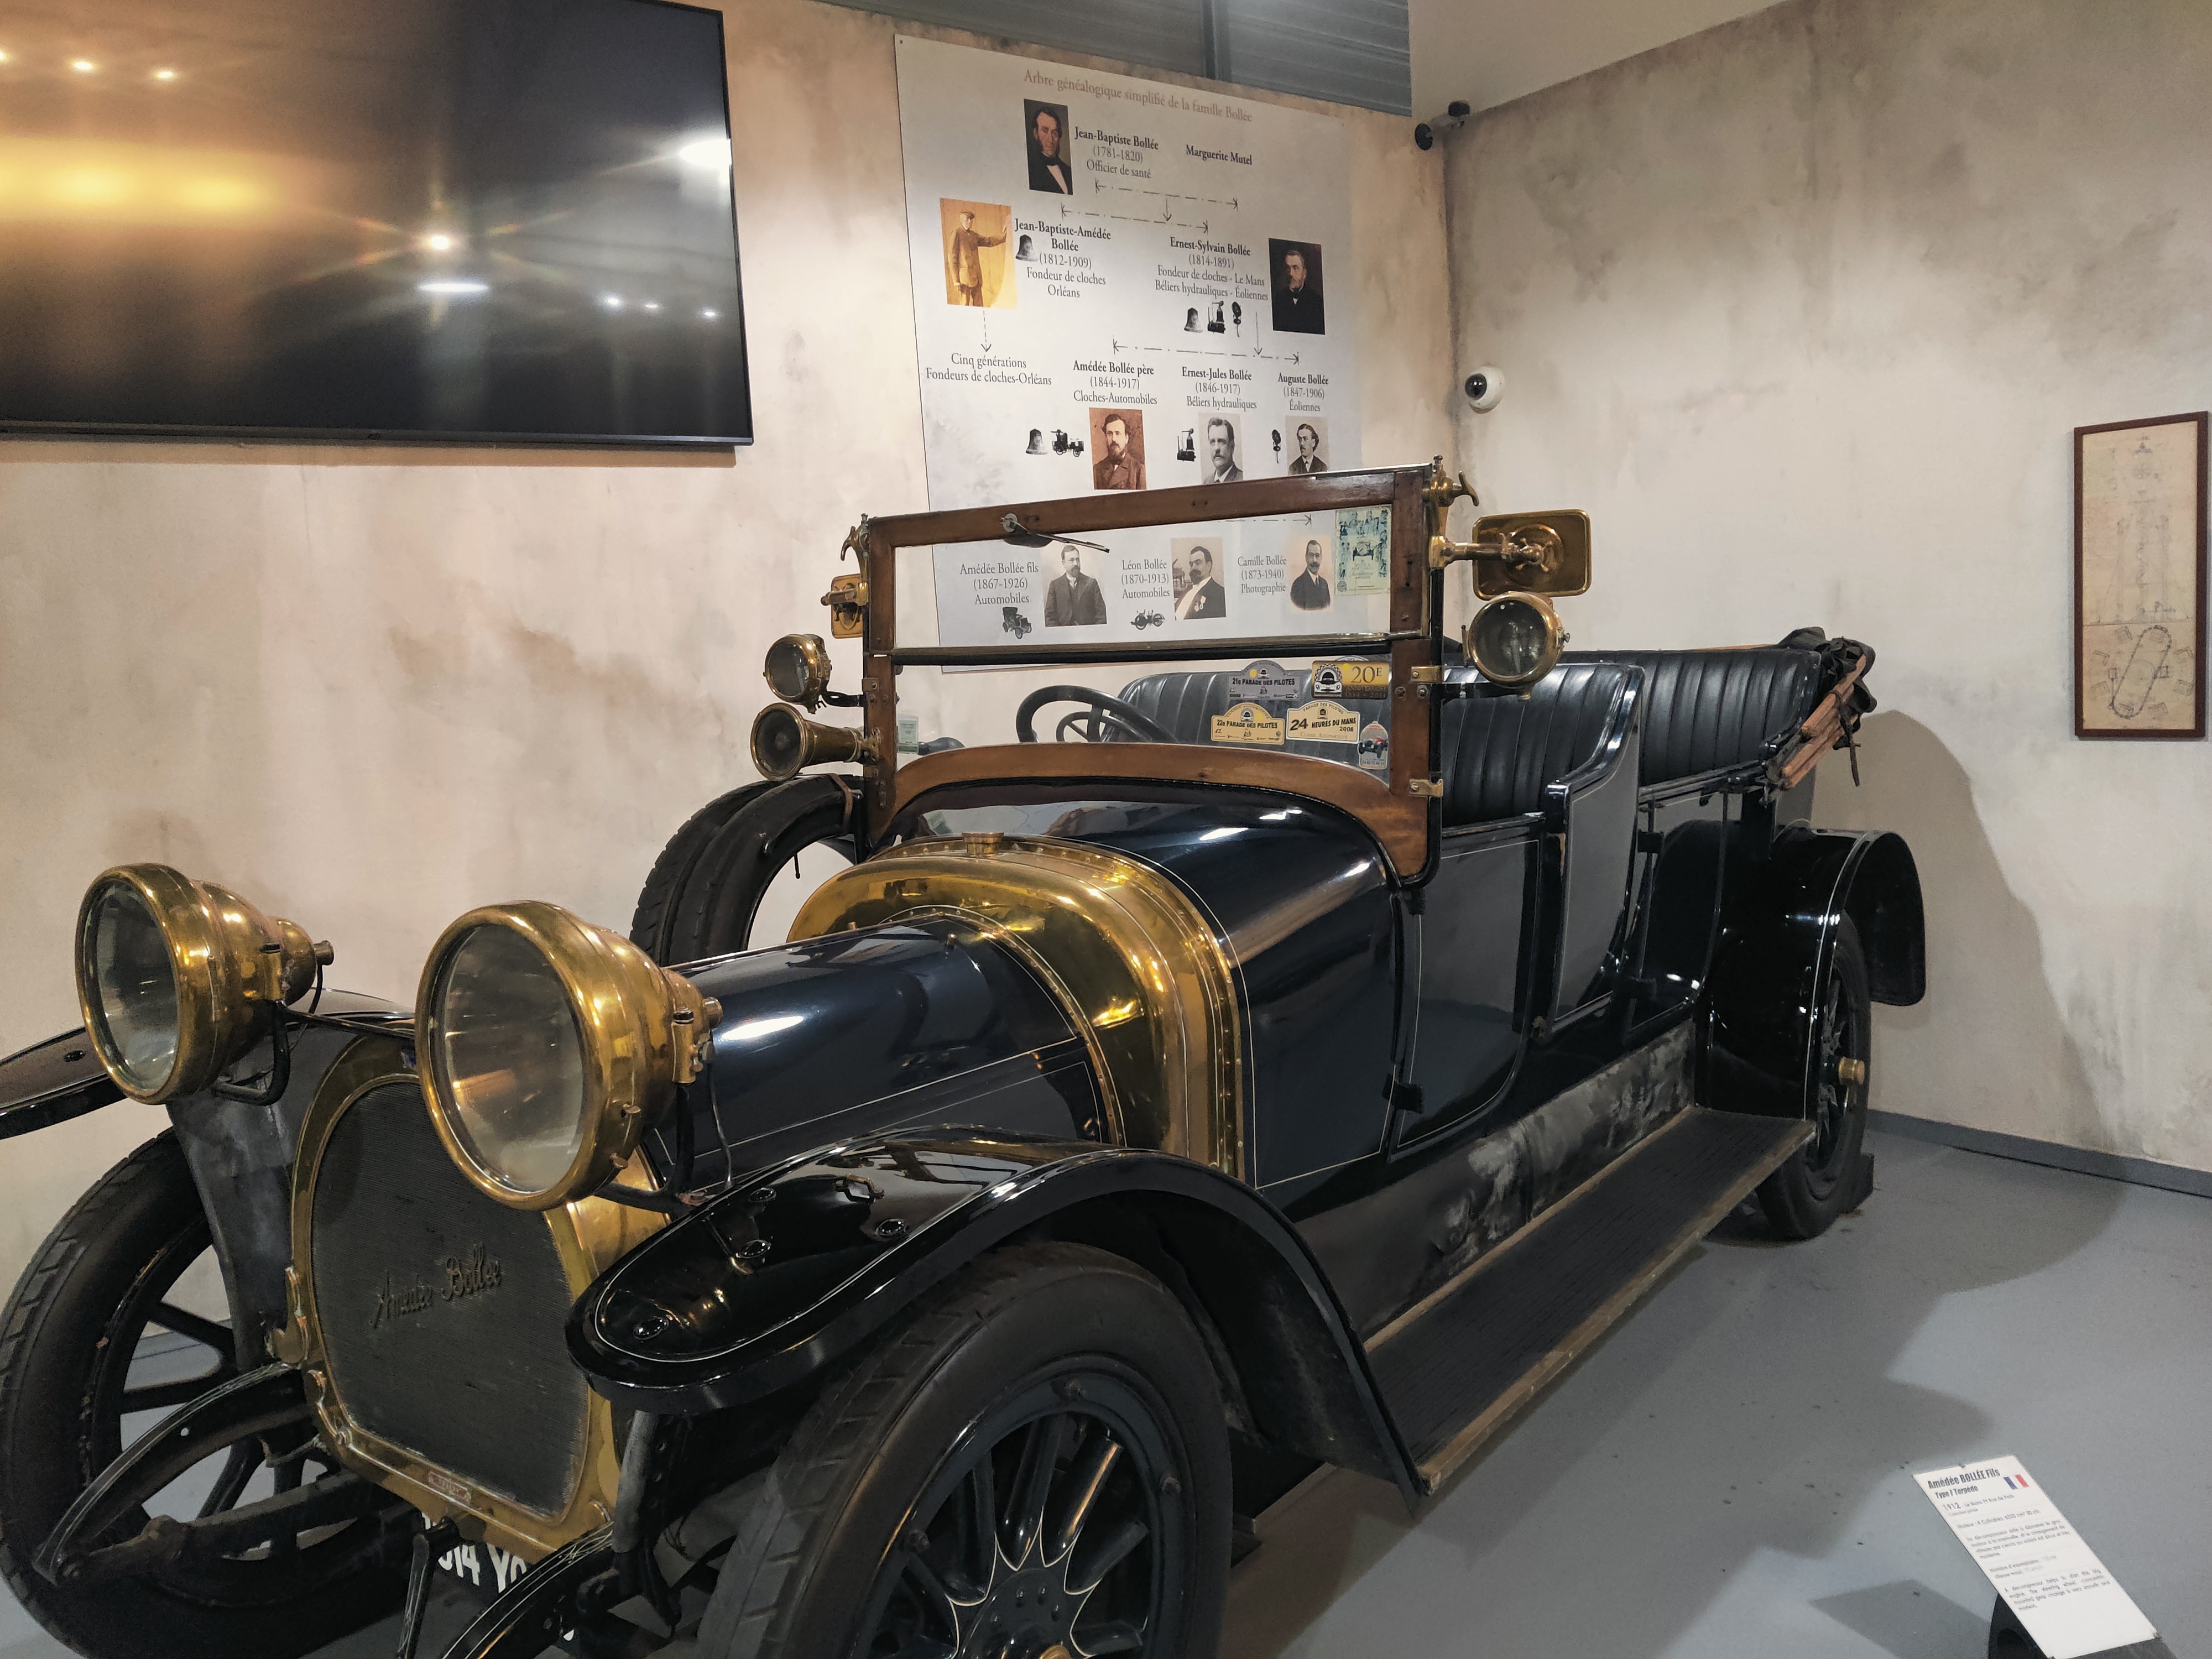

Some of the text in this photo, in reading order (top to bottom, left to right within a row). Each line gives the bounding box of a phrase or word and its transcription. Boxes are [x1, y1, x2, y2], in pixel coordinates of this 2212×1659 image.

[1024, 70, 1252, 122] Arbre généalogique simplifié de la famille Bollée
[1074, 127, 1159, 150] Jean-Baptiste Bollée
[1093, 146, 1143, 163] (1781-1820)
[1186, 145, 1253, 165] Marguerite Mutel
[1087, 159, 1151, 179] Officier de santé
[1015, 218, 1111, 239] Jean-Baptiste-Amédée
[1052, 238, 1078, 251] Bollée
[1170, 237, 1250, 256] Ernest-Sylvain Bollée
[1040, 252, 1091, 270] (1812-1909)
[1189, 254, 1234, 269] (1814-1891)
[1027, 267, 1105, 285] Fondeur de cloches
[1158, 265, 1189, 278] Fondeur
[1191, 269, 1199, 279] de
[1202, 270, 1227, 282] cloches
[1235, 273, 1243, 284] Le
[1246, 274, 1265, 286] Mans
[1048, 285, 1080, 298] Orléans
[1155, 279, 1180, 292] Béliers
[1182, 282, 1228, 299] hydrauliques
[1235, 286, 1268, 301] Éoliennes
[951, 353, 1026, 369] Cinq générations
[1073, 360, 1154, 376] Amédée Bollée père
[1182, 367, 1251, 380] Ernest-Jules Bollée
[926, 368, 1052, 385] Fondeurs de cloches-Orléans
[1091, 376, 1140, 390] (1844-1917)
[1278, 373, 1328, 386] Auguste Bollée
[1195, 382, 1240, 395] (1846-1917)
[1284, 387, 1324, 399] (1847-1906)
[1073, 390, 1157, 405] Cloches-Automobiles
[1187, 396, 1257, 411] Béliers hydrauliques
[1290, 399, 1321, 411] Éoliennes
[1122, 559, 1167, 571] Léon Bollée
[1237, 556, 1286, 567] Camille Bollée
[960, 562, 1039, 575] Amédée Bollée fils
[1241, 569, 1284, 581] (1873-1940)
[973, 578, 1028, 590] (1867-1926)
[1121, 573, 1169, 585] (1870-1913)
[1122, 588, 1170, 599] Automobiles
[1241, 583, 1286, 595] Photographie
[975, 593, 1029, 606] Automobiles
[1303, 703, 1318, 712] PARADE
[1329, 704, 1344, 714] PILOTES
[1290, 718, 1308, 731] 24
[1928, 1477, 1959, 1489] Amédée
[1959, 1470, 1986, 1483] BOLLÉE
[1935, 1490, 1949, 1499] Type
[1943, 1503, 1961, 1511] 1912
